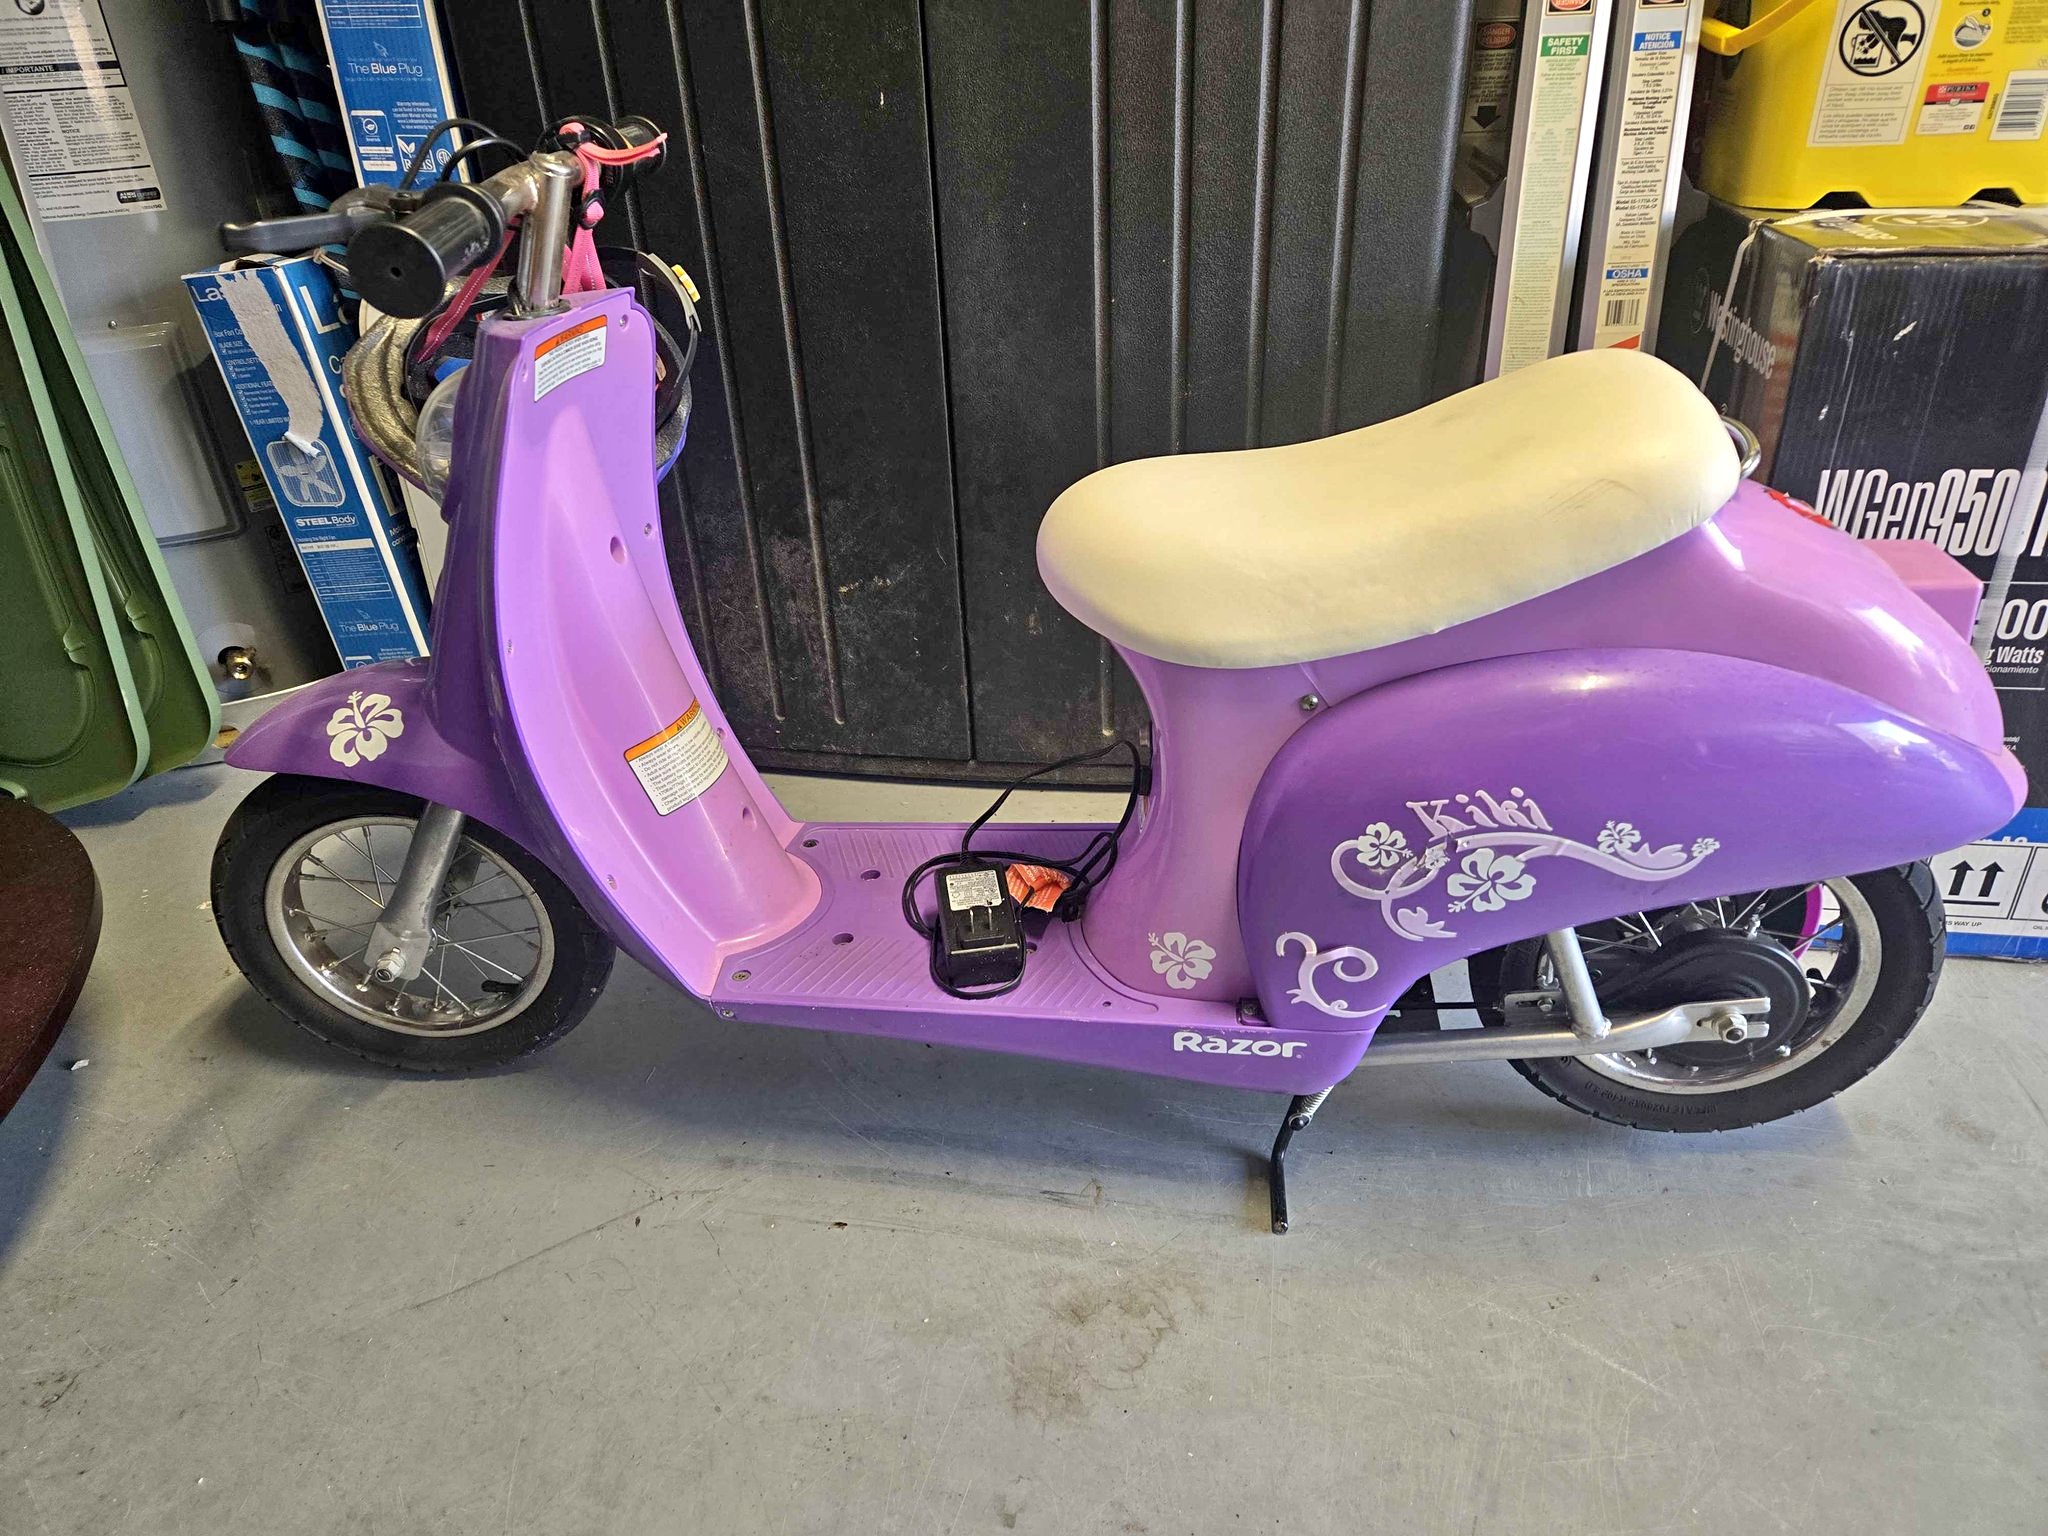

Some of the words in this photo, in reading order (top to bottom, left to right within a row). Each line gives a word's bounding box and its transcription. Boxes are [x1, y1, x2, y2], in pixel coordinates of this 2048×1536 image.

[1547, 37, 1584, 46] SAFETY
[1645, 33, 1671, 41] NOTICE
[1551, 47, 1579, 55] FIRST
[6, 65, 54, 73] IMPORTANTE
[348, 63, 369, 74] The
[370, 63, 397, 74] Blue
[398, 63, 423, 77] Plug
[1612, 269, 1642, 278] OSHA
[191, 286, 225, 302] La
[339, 624, 356, 633] The
[356, 623, 378, 631] Blue
[378, 622, 399, 632] Plug
[1996, 646, 2044, 664] Watts
[1985, 665, 2039, 674] cionamiento
[1406, 787, 1553, 842] Kiki
[1173, 1031, 1308, 1058] Razor
